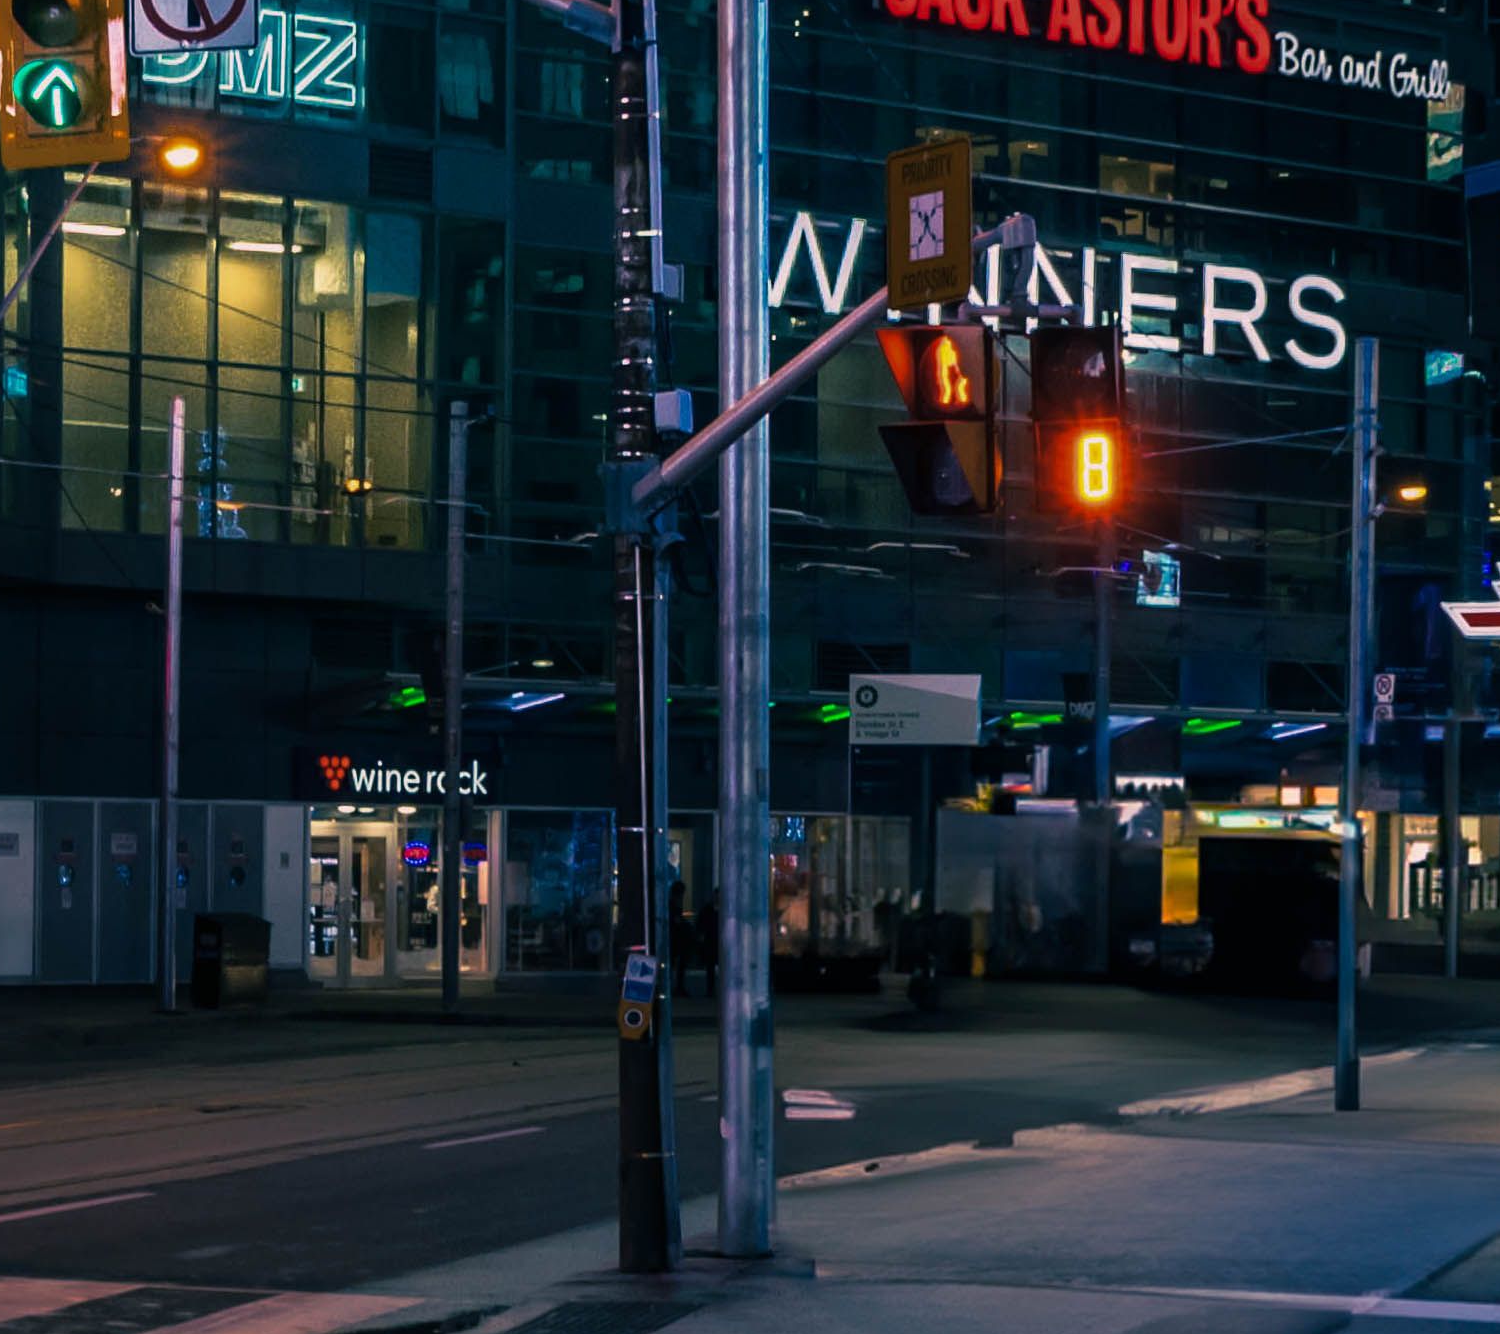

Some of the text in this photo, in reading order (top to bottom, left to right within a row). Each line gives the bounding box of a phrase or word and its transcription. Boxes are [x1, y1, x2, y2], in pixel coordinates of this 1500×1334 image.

[1273, 31, 1333, 78] Bar
[1340, 50, 1382, 90] and
[1388, 53, 1452, 101] Grill
[768, 210, 1349, 371] WNERS
[902, 265, 957, 294] CROSSING
[351, 758, 421, 794] wine
